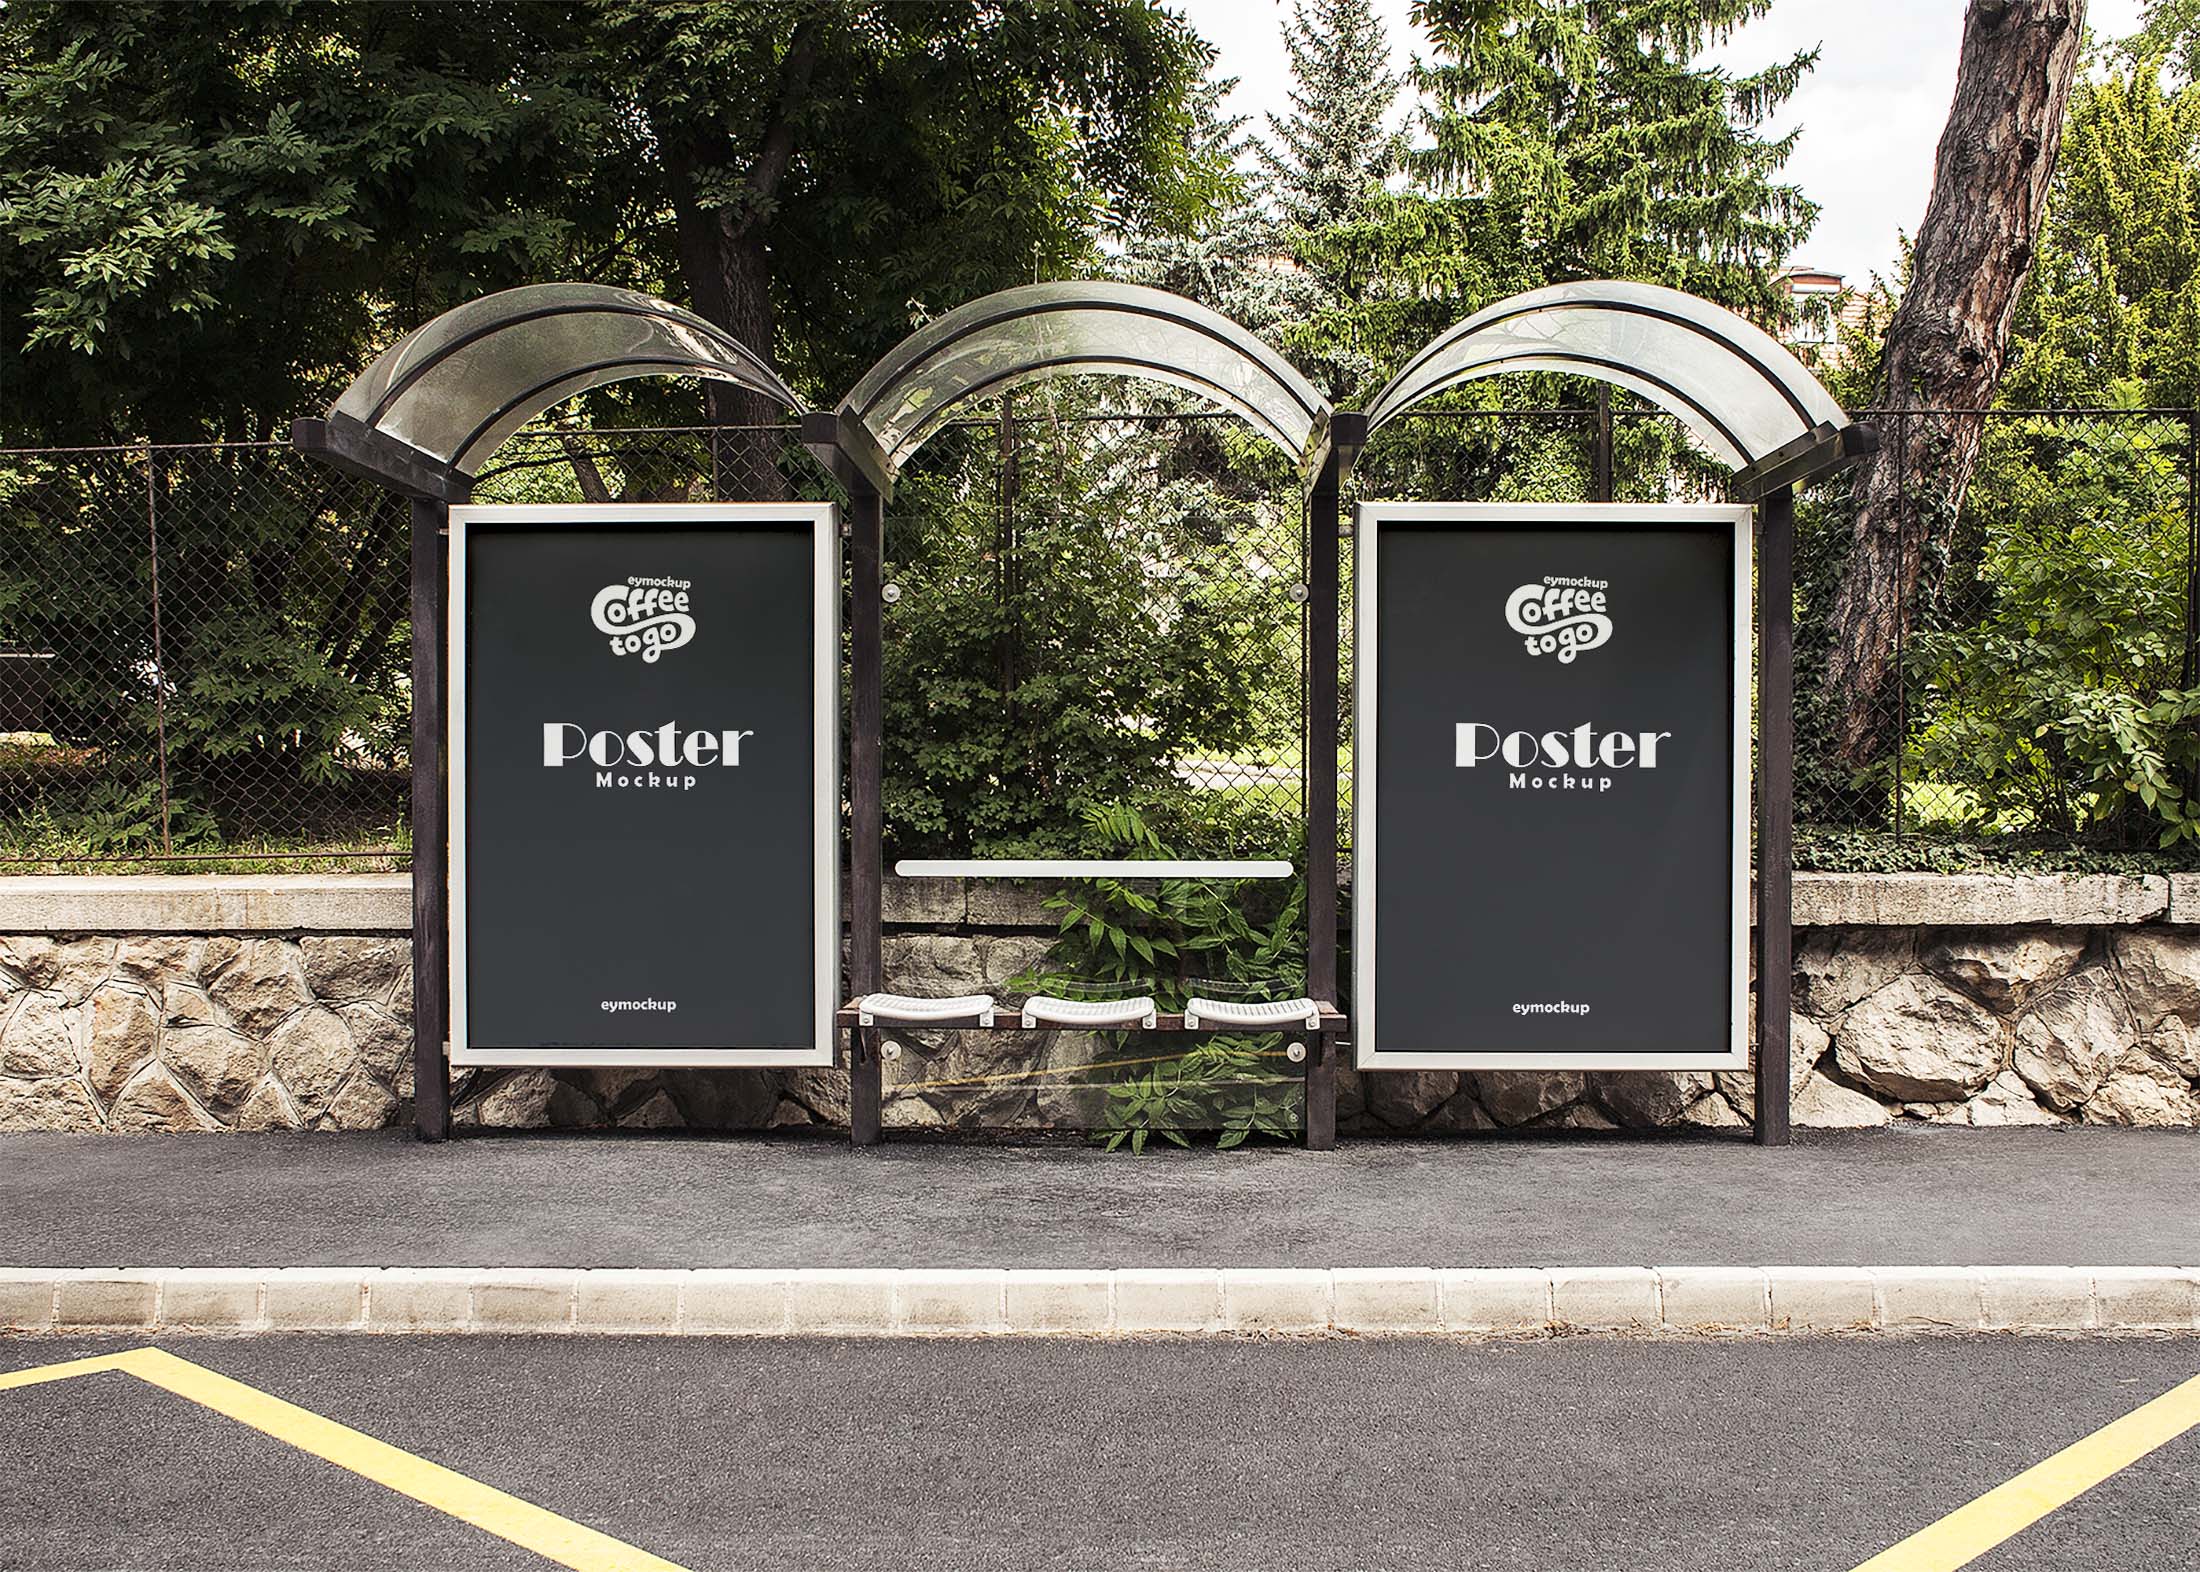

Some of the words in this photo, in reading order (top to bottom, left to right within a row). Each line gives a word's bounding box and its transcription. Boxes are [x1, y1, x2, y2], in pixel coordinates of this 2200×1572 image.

[627, 576, 692, 591] eymockup
[1543, 576, 1609, 590] eymockup
[591, 584, 691, 635] Coffee
[1505, 583, 1608, 635] Coffee
[543, 720, 754, 767] Poster
[1455, 721, 1672, 768] Poster
[596, 771, 697, 791] Mockup
[1509, 772, 1612, 792] Mockup
[600, 997, 677, 1013] eymockup
[1512, 1000, 1591, 1016] eymockup
